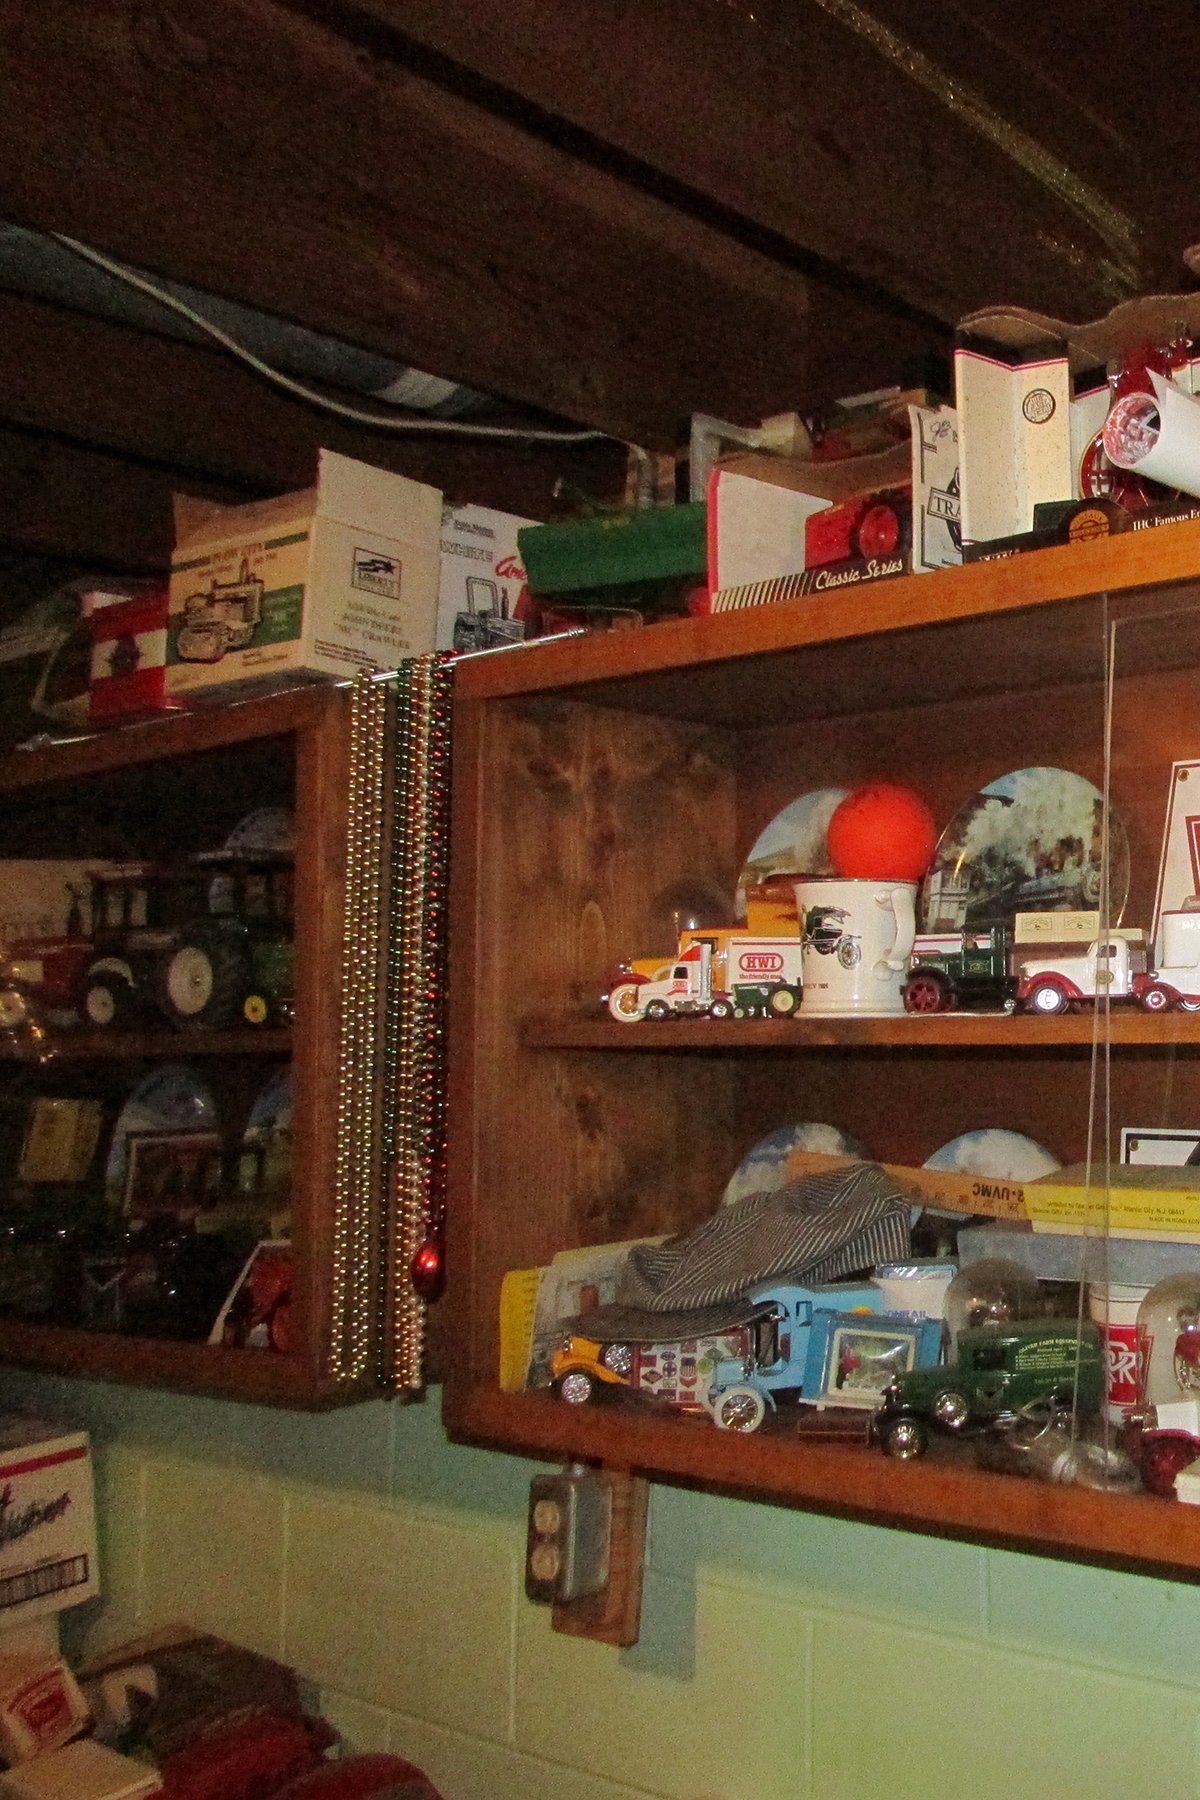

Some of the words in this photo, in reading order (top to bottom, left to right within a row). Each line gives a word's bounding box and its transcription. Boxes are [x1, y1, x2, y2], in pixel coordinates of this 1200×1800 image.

[1132, 518, 1152, 532] IHC
[1154, 511, 1190, 528] Famous
[815, 569, 861, 591] Classic
[862, 558, 903, 580] Series
[746, 956, 776, 969] HWI
